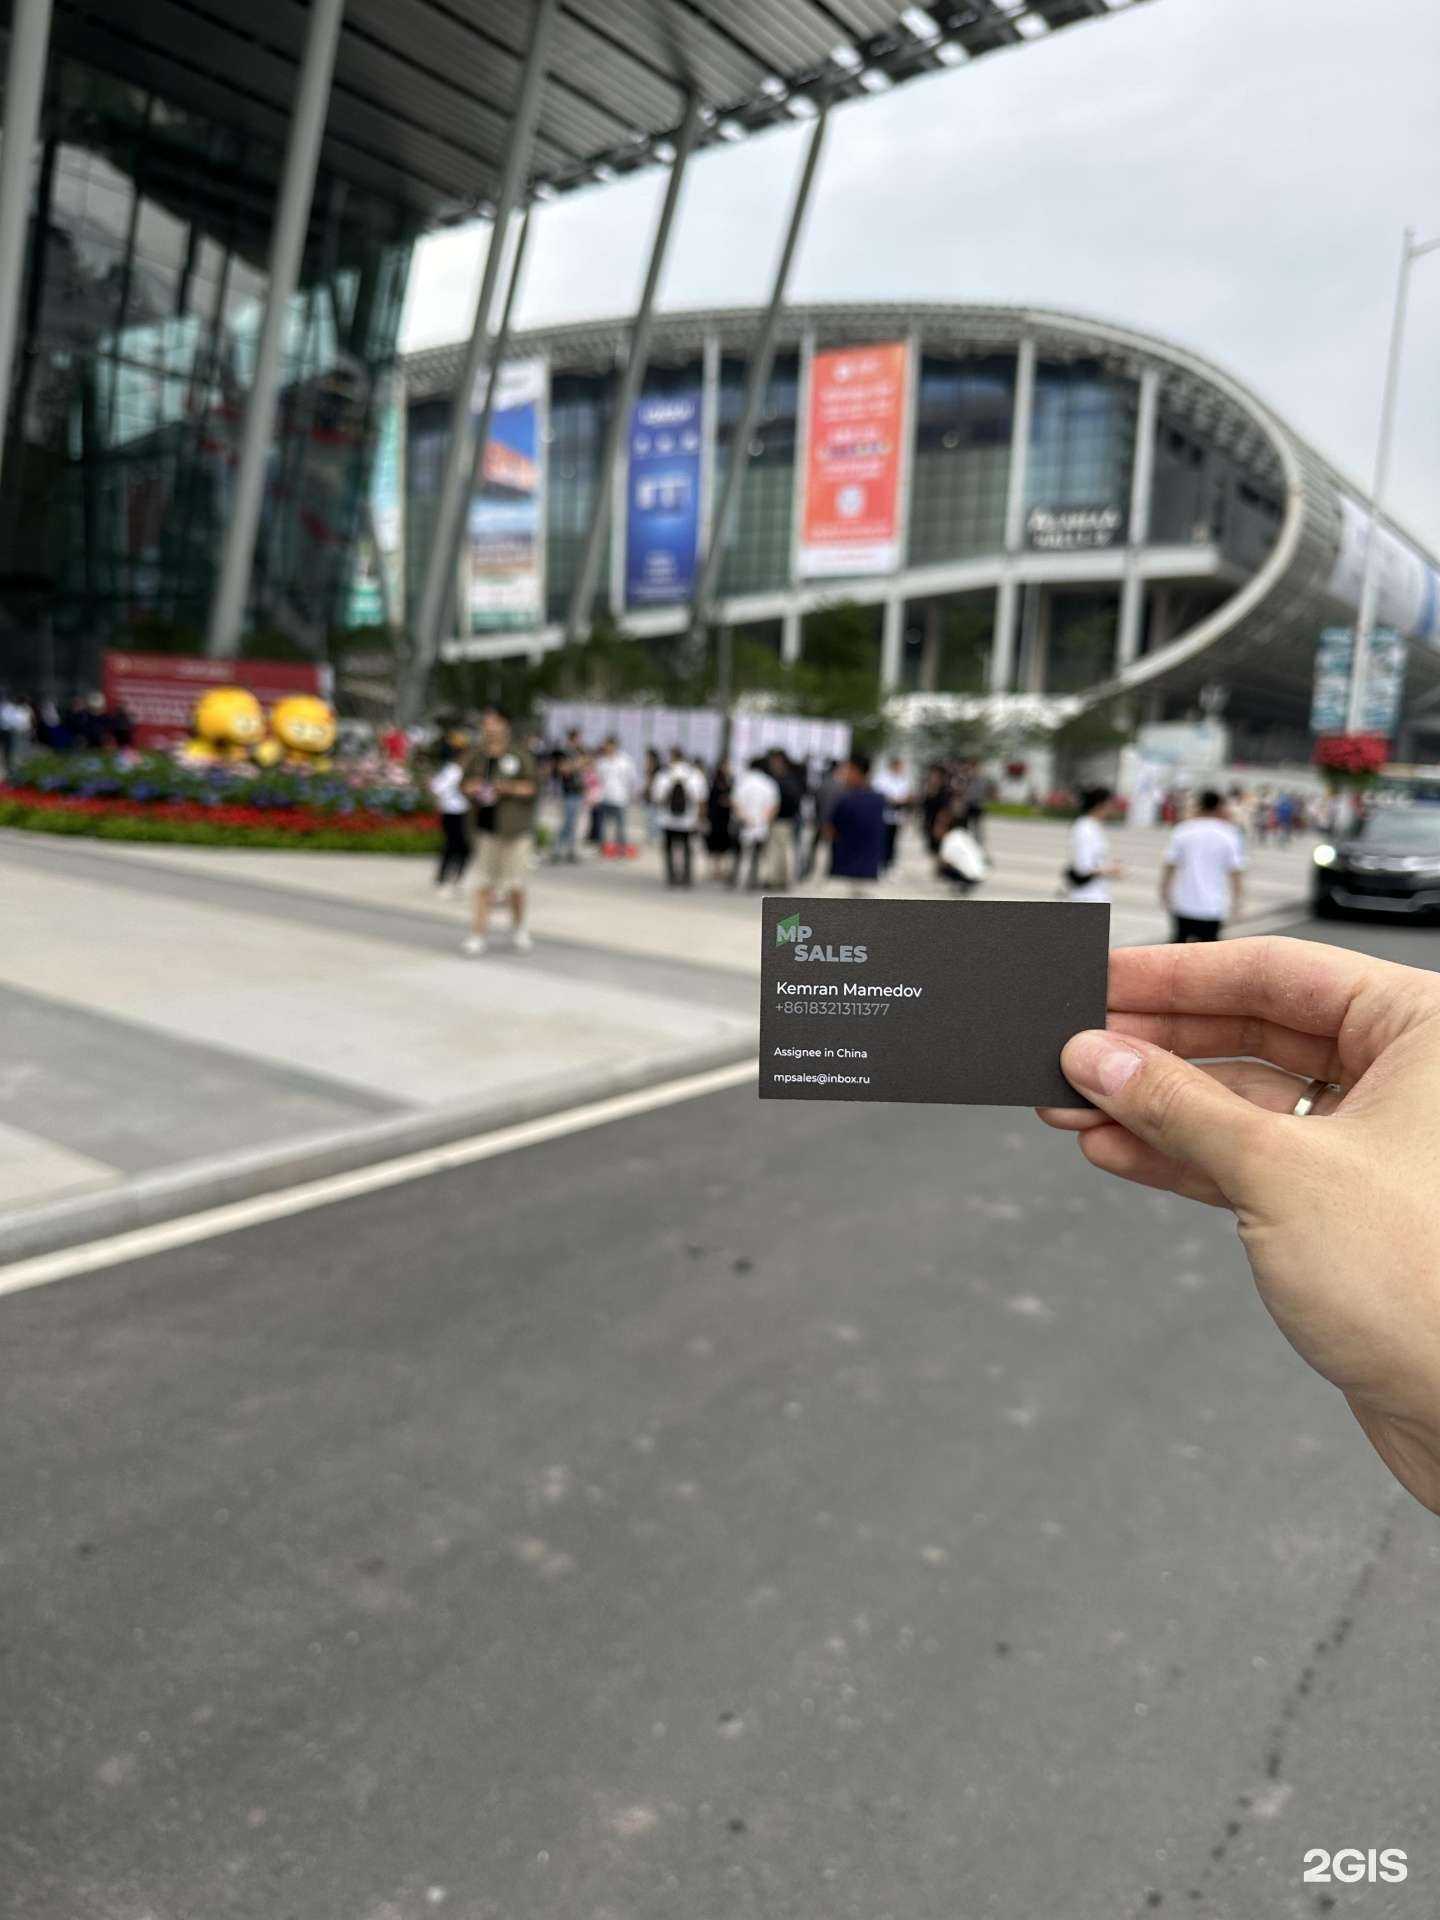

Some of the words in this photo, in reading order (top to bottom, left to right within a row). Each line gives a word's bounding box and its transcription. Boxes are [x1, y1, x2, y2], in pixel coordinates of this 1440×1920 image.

[776, 925, 813, 943] MP
[794, 944, 868, 963] SALES
[776, 981, 839, 996] Kemran
[843, 983, 922, 998] Mamedov
[775, 1001, 890, 1016] +8618321311377
[773, 1047, 822, 1059] Assignee
[824, 1047, 835, 1058] in
[836, 1048, 868, 1059] China
[773, 1072, 871, 1085] mpsales@inbox.ru
